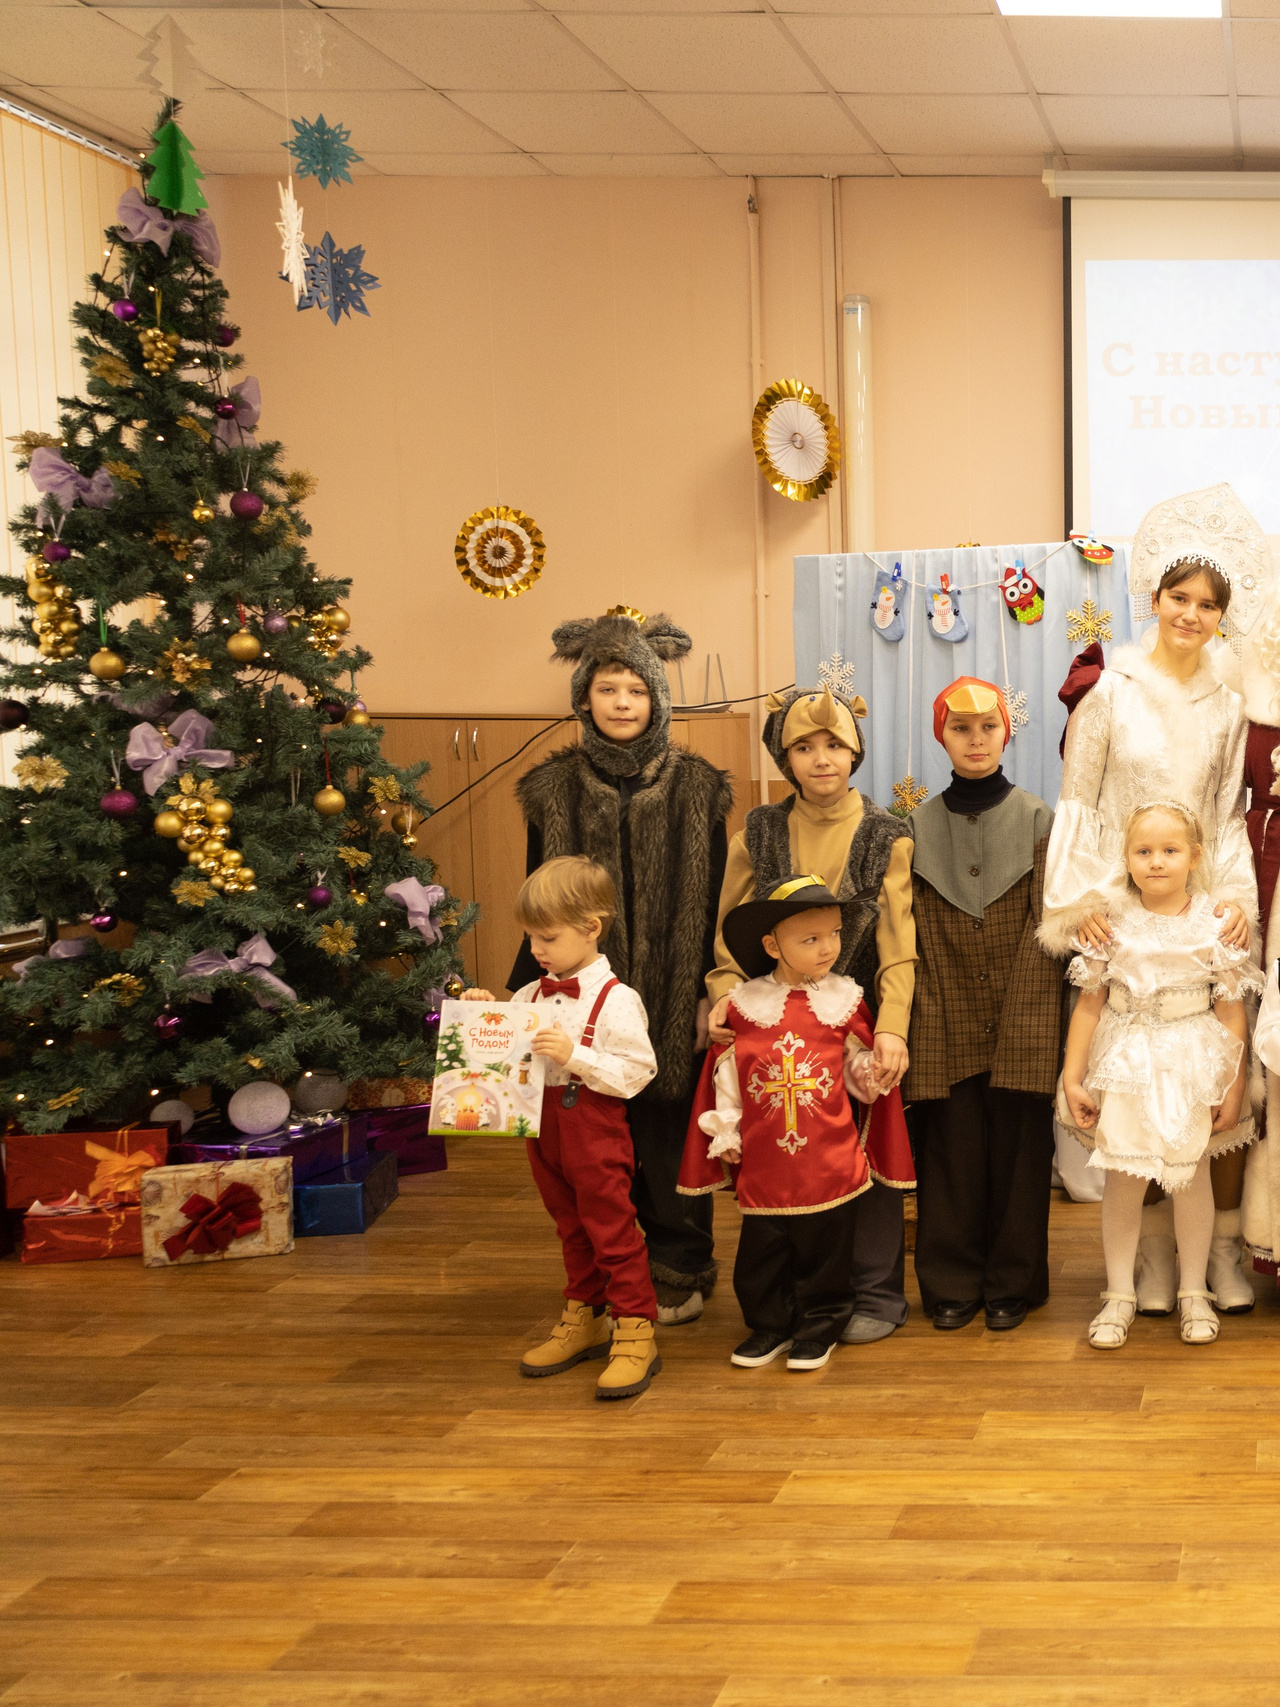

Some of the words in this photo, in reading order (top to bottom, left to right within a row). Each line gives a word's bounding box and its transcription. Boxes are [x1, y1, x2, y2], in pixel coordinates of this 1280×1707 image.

[1101, 342, 1135, 377] С
[469, 1027, 477, 1037] С
[479, 1027, 514, 1038] Новым
[471, 1038, 510, 1049] Годом!
